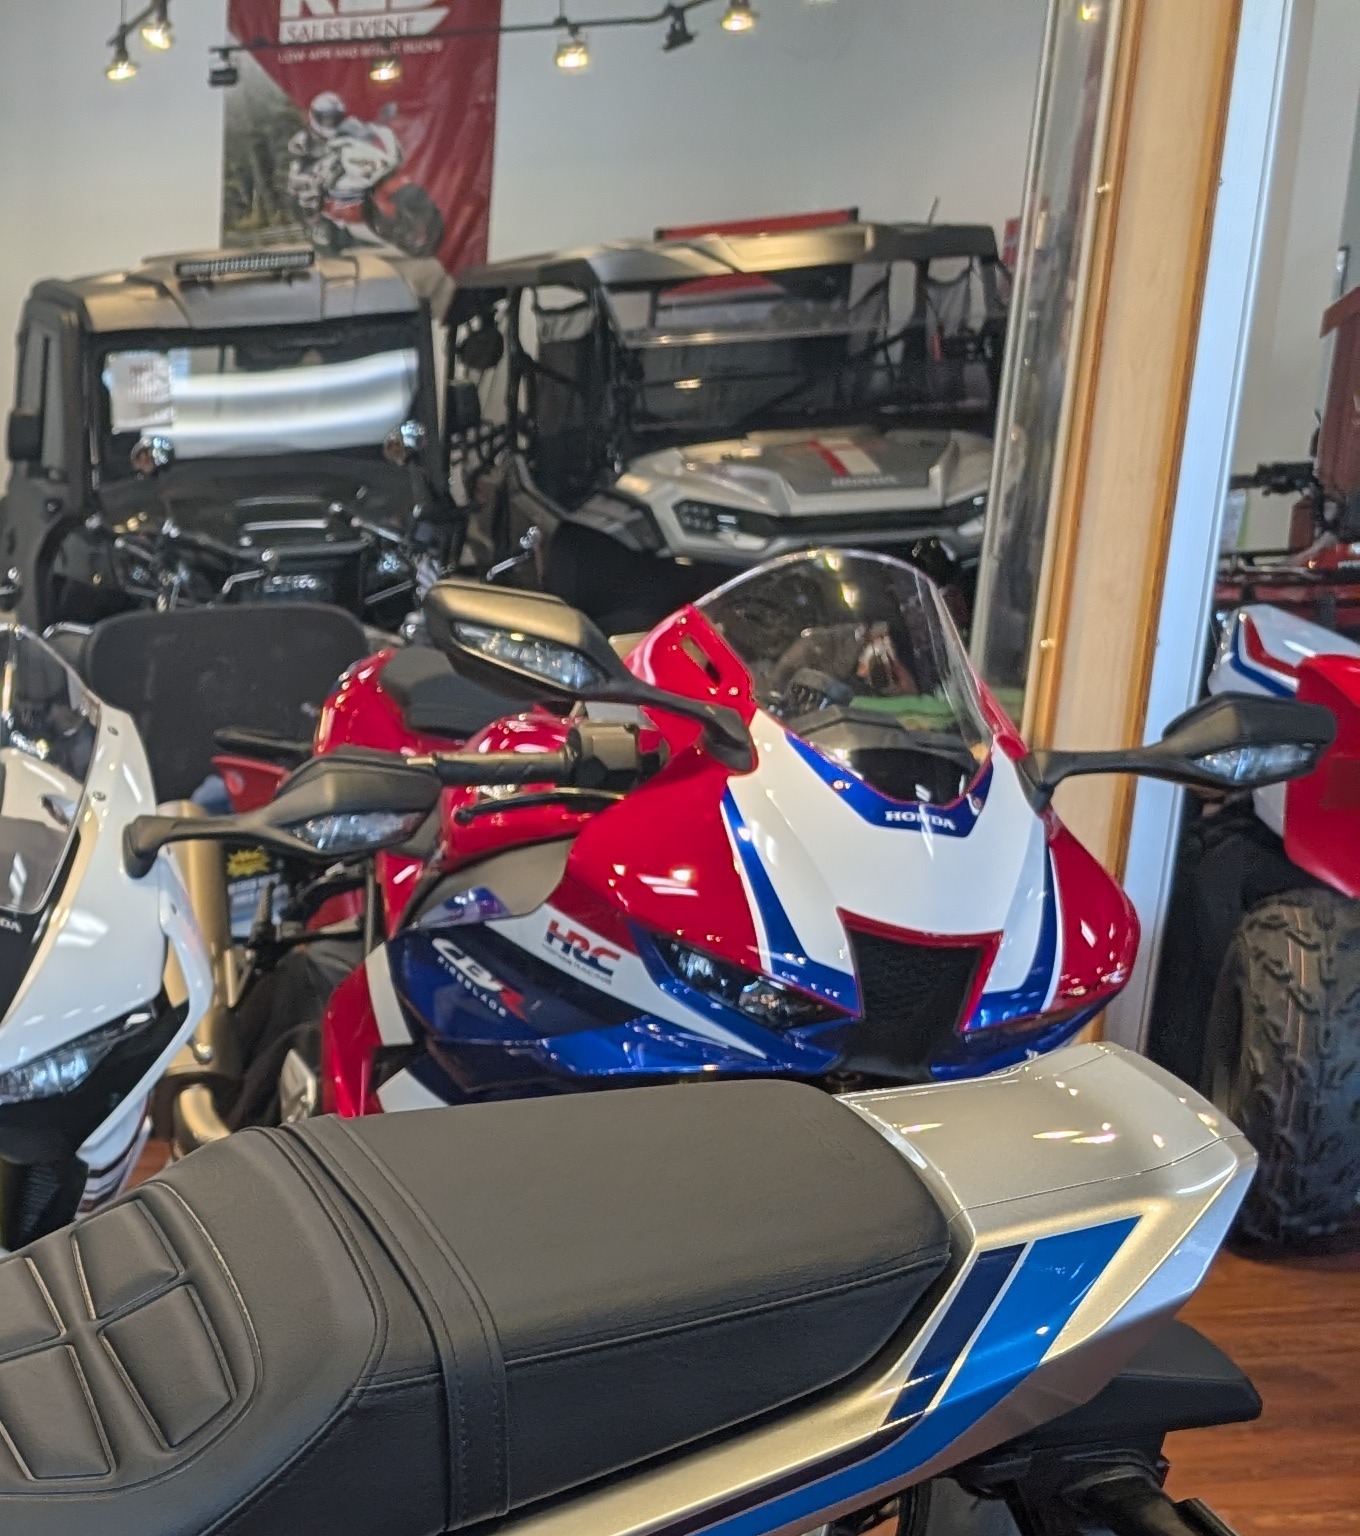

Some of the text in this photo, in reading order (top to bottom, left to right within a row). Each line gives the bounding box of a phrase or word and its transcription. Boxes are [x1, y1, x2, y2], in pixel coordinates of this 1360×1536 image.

[285, 16, 415, 41] SALES EVENT
[884, 810, 956, 831] HONDA
[544, 919, 622, 978] HRC
